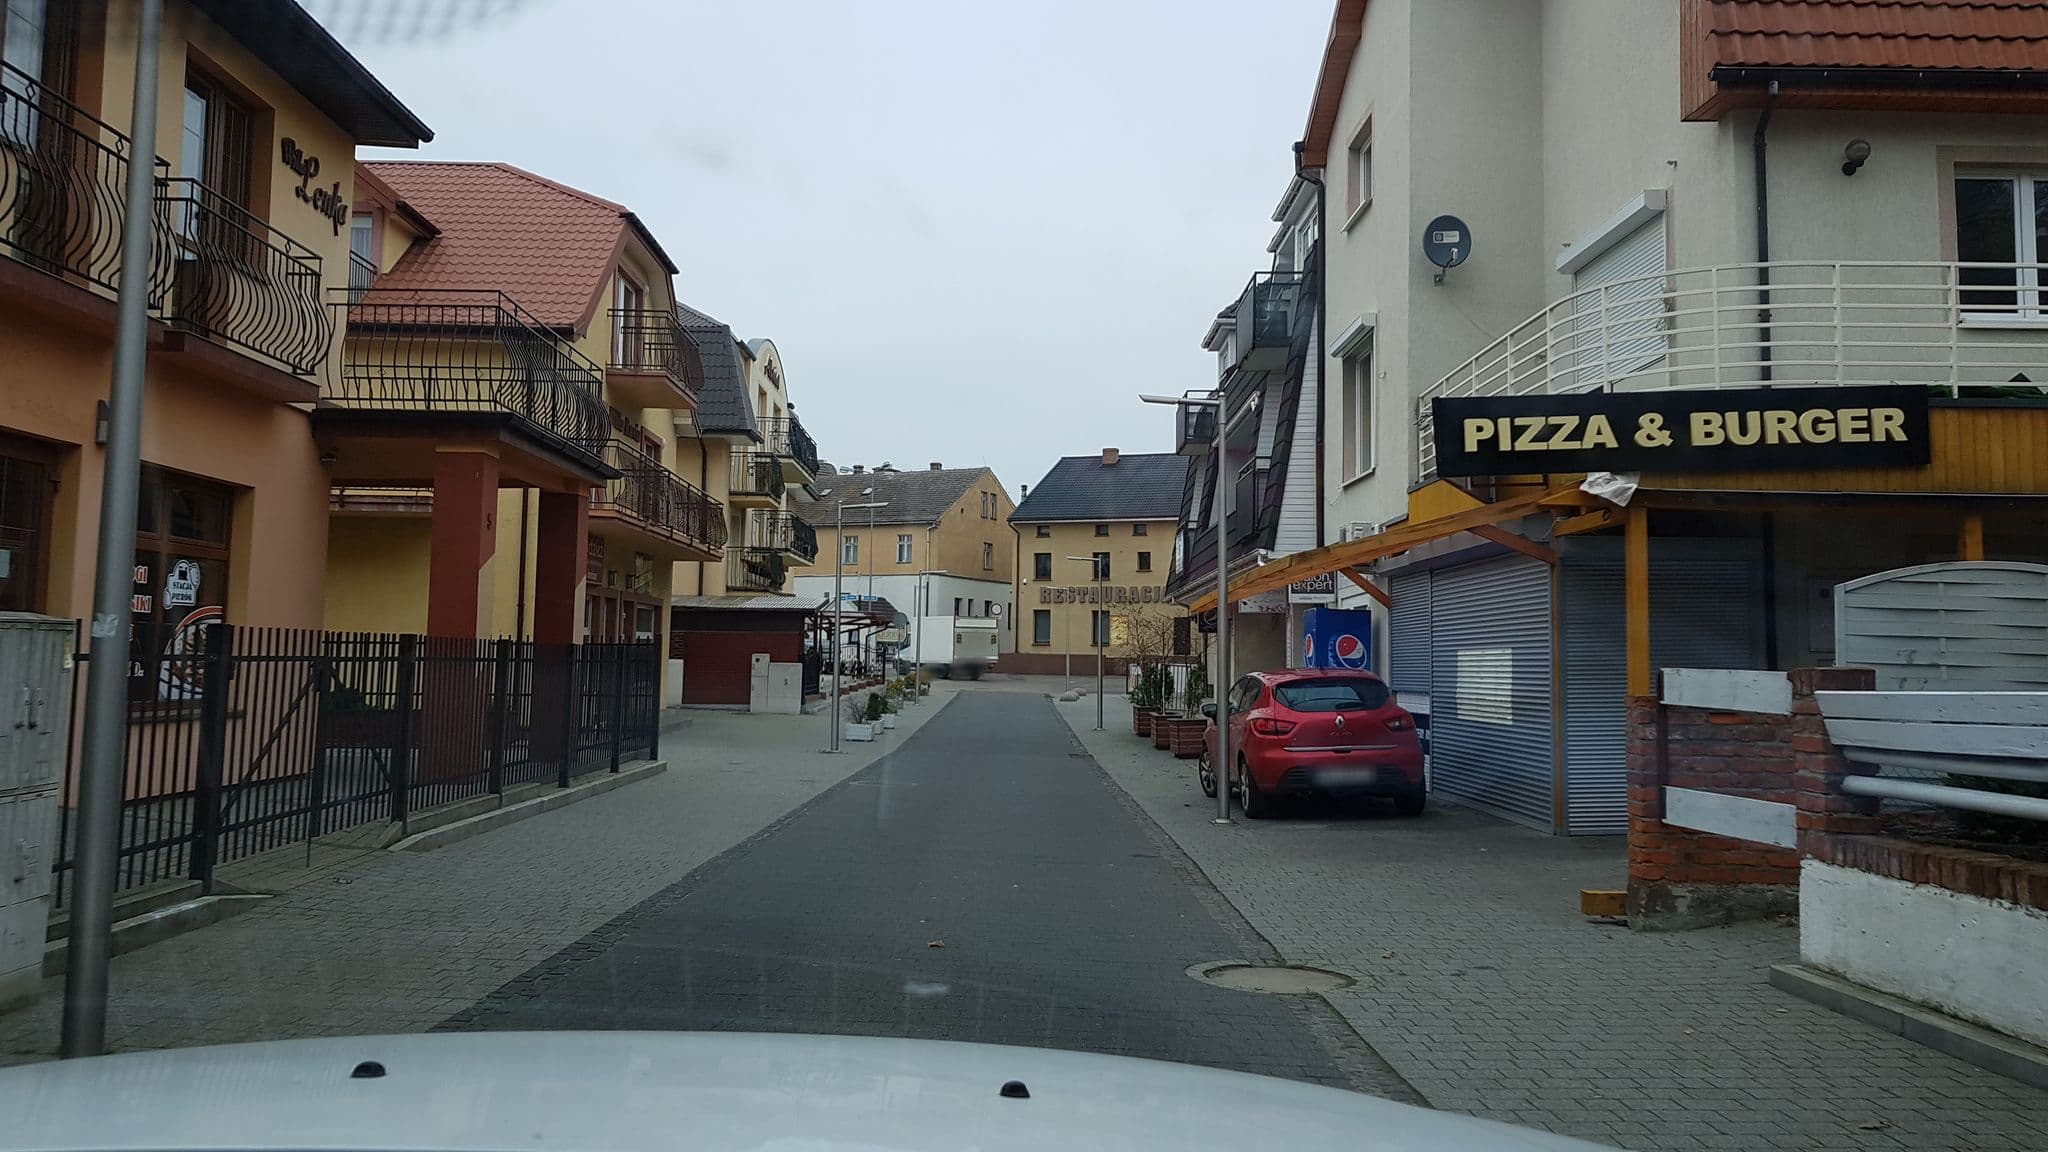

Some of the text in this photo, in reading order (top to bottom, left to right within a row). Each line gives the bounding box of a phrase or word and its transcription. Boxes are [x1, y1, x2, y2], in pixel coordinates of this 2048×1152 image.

[1463, 407, 1908, 452] PIZZA & BURGER
[1292, 581, 1333, 592] expert
